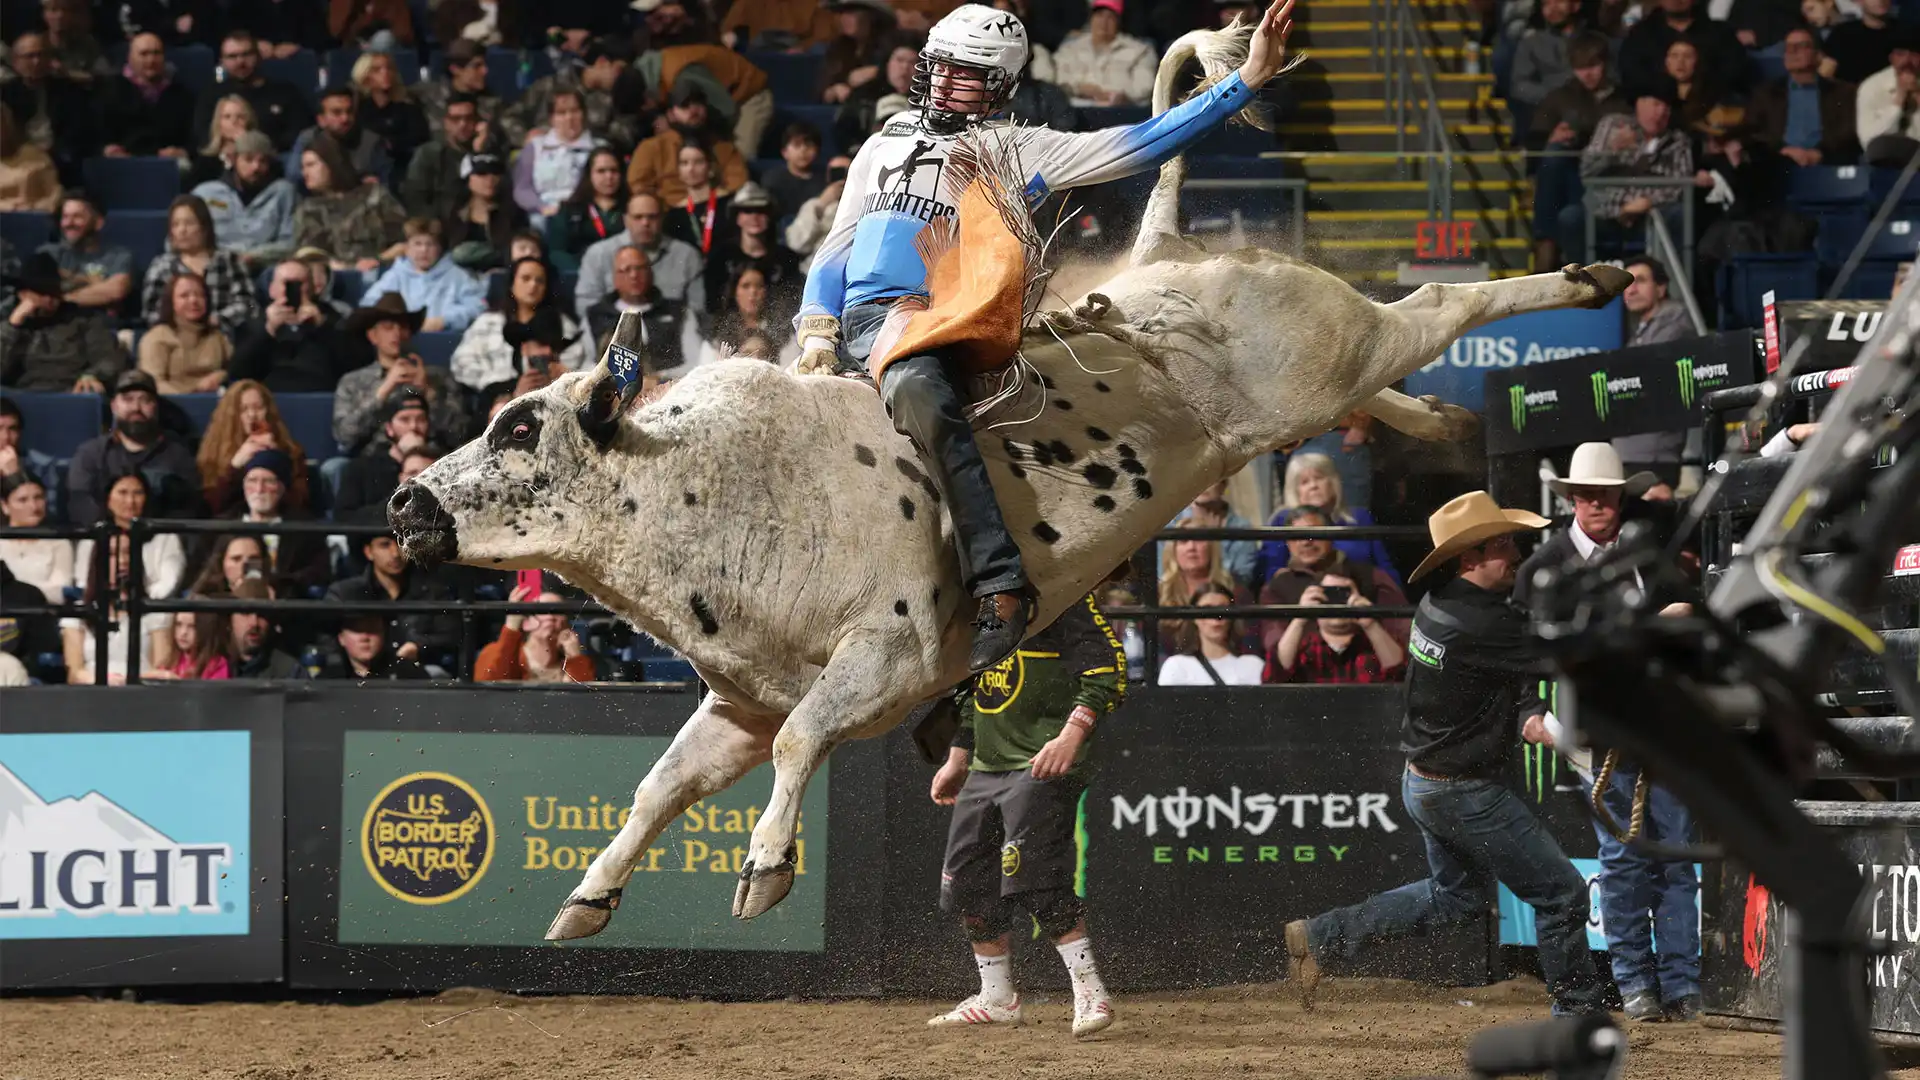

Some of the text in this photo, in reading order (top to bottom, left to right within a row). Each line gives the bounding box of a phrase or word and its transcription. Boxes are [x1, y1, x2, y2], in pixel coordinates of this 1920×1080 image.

[1415, 221, 1476, 259] EXIT
[614, 354, 633, 370] 35
[1450, 336, 1519, 368] UBS
[407, 793, 450, 816] U.S.
[683, 799, 803, 833] Stat
[1111, 786, 1398, 838] MONSTER
[380, 822, 475, 844] BORDER
[379, 846, 474, 869] PATROL
[681, 838, 808, 875] Patl
[1153, 845, 1349, 863] ENERGY
